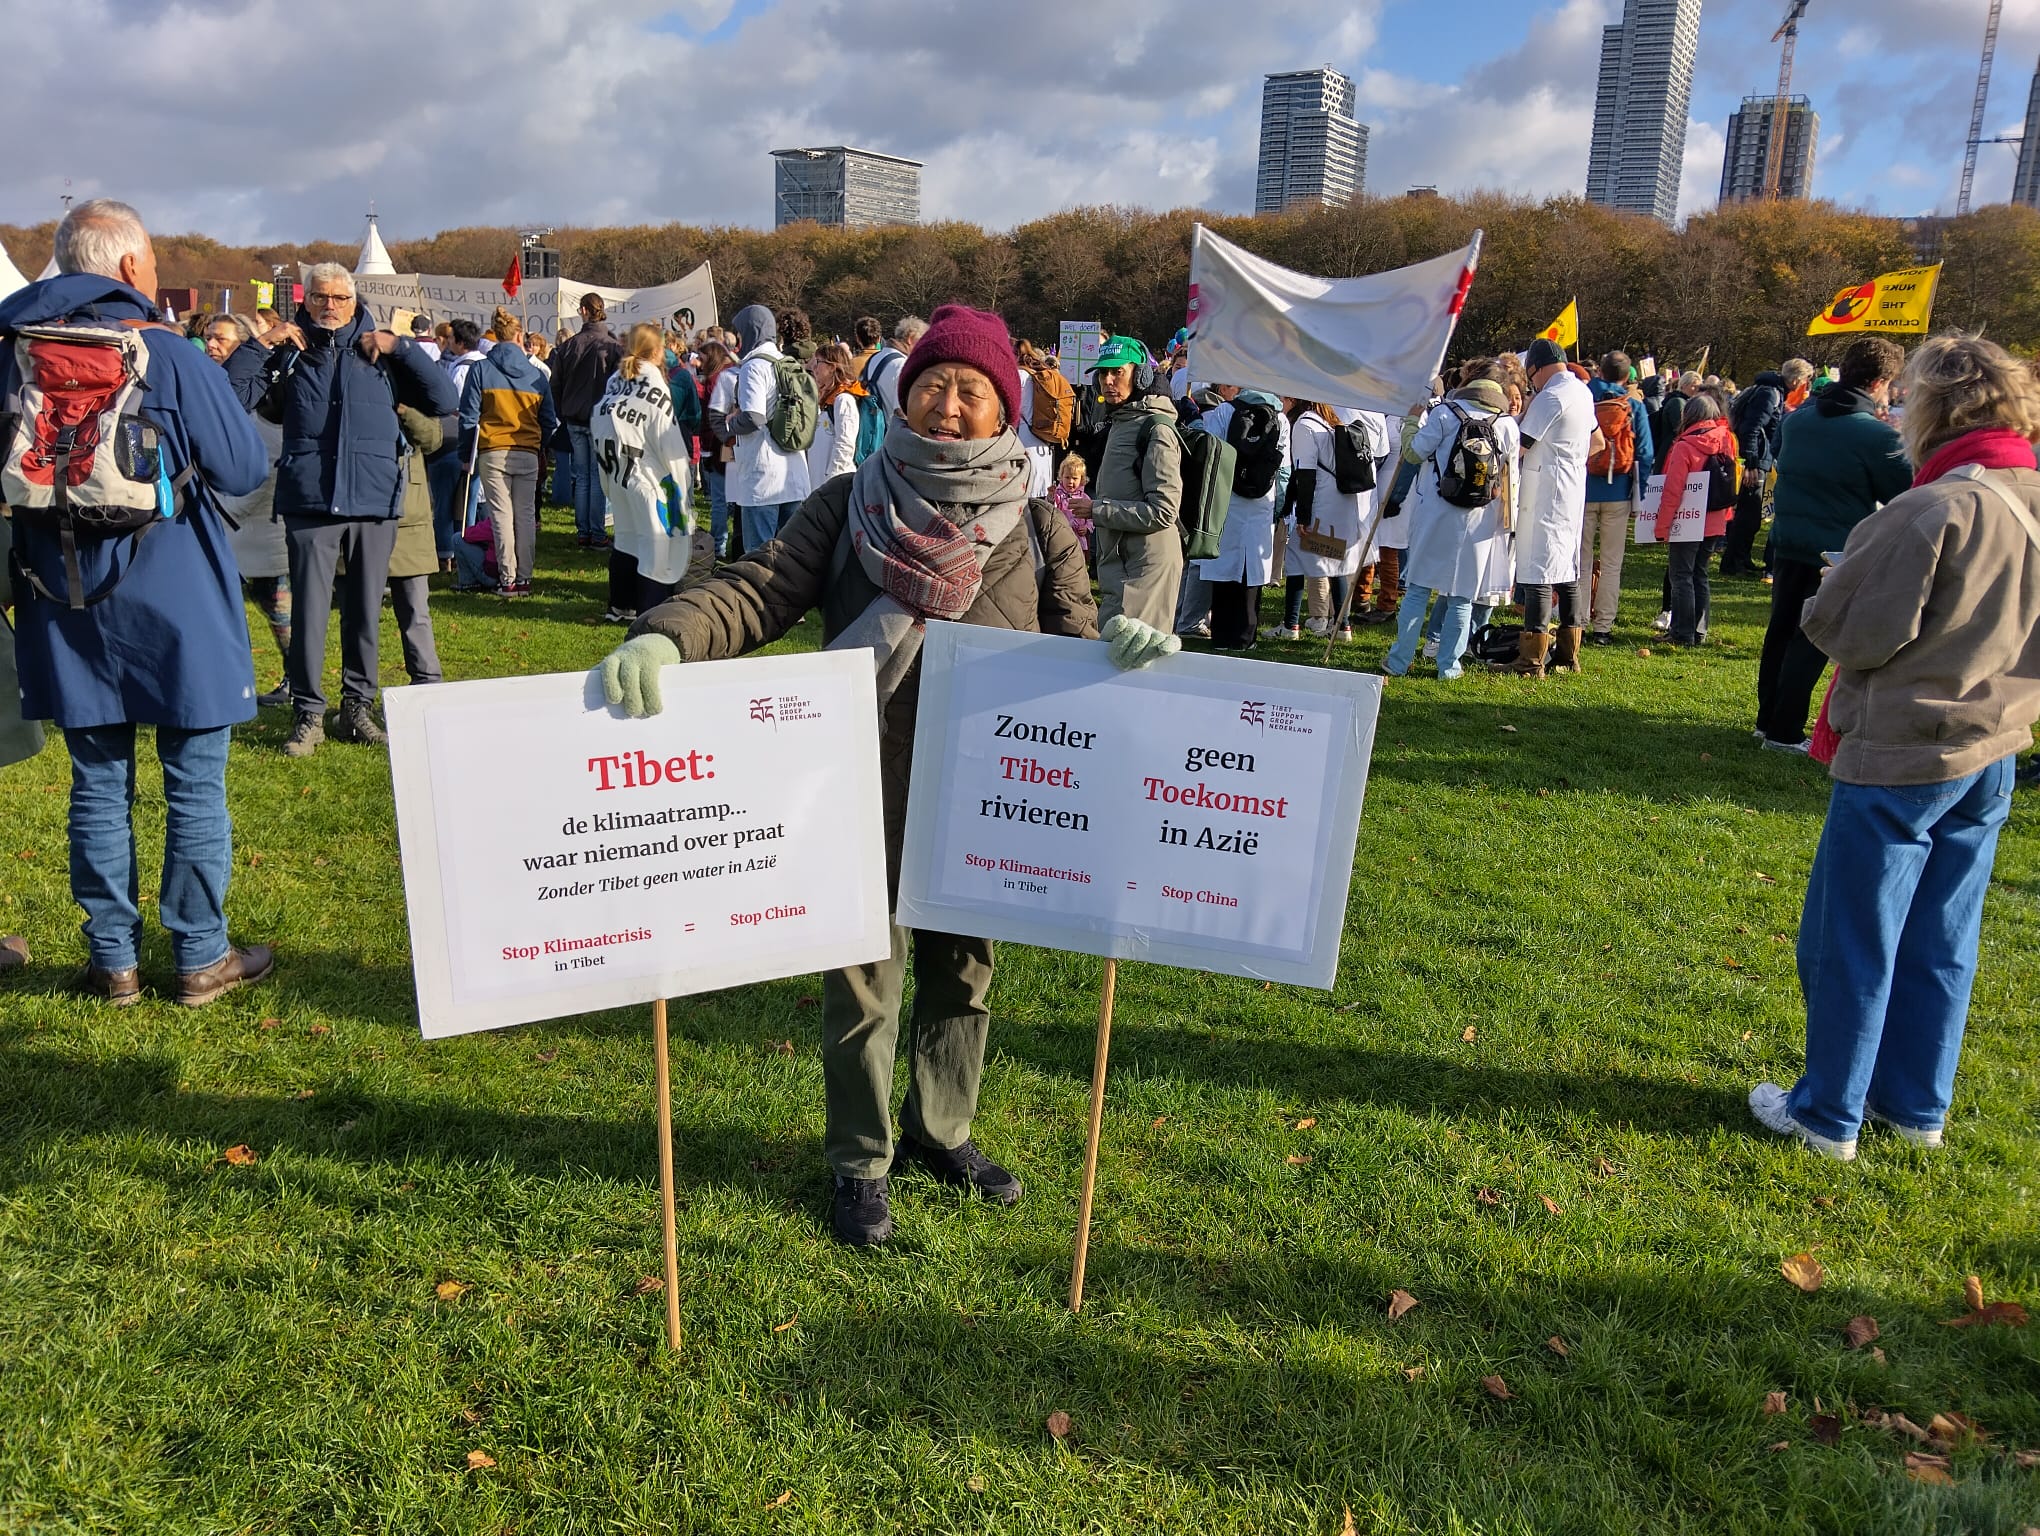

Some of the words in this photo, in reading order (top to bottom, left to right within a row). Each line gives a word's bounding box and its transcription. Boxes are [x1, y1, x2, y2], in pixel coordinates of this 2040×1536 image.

[600, 398, 648, 426] beter
[779, 700, 811, 709] SUPPORT
[779, 708, 803, 716] GROEP
[780, 712, 822, 721] NEDERLAND
[1270, 711, 1304, 721] SUPPORT
[1271, 704, 1293, 713] TIBET
[993, 713, 1097, 750] Zonder
[1268, 723, 1313, 734] NEDERLAND
[1269, 717, 1294, 725] GROEP
[588, 749, 716, 791] Tibet:
[999, 756, 1081, 790] Tibets
[1184, 746, 1256, 773] geen
[1143, 776, 1289, 819] Toekomst
[979, 794, 1090, 831] rivieren
[562, 817, 588, 836] de
[1159, 819, 1188, 846] in
[1194, 826, 1259, 856] Azië
[522, 850, 578, 872] waar
[584, 835, 679, 864] niemand
[684, 830, 728, 851] over
[733, 822, 785, 848] praat
[537, 880, 595, 901] Zonder
[599, 874, 640, 893] Tibet
[643, 870, 679, 890] geen
[682, 863, 724, 881] water
[728, 860, 743, 875] in
[745, 855, 777, 872] Azië
[965, 852, 996, 871] Stop
[999, 857, 1092, 884] Klimaatcrisis
[1161, 885, 1193, 903] Stop
[1196, 889, 1239, 908] China
[1003, 877, 1016, 890] in
[1017, 879, 1048, 895] Tibet
[502, 943, 540, 961] Stop
[544, 926, 652, 954] Klimaatcrisis
[730, 911, 762, 926] Stop
[765, 903, 806, 921] China
[554, 959, 568, 972] in
[570, 954, 605, 970] Tibet
